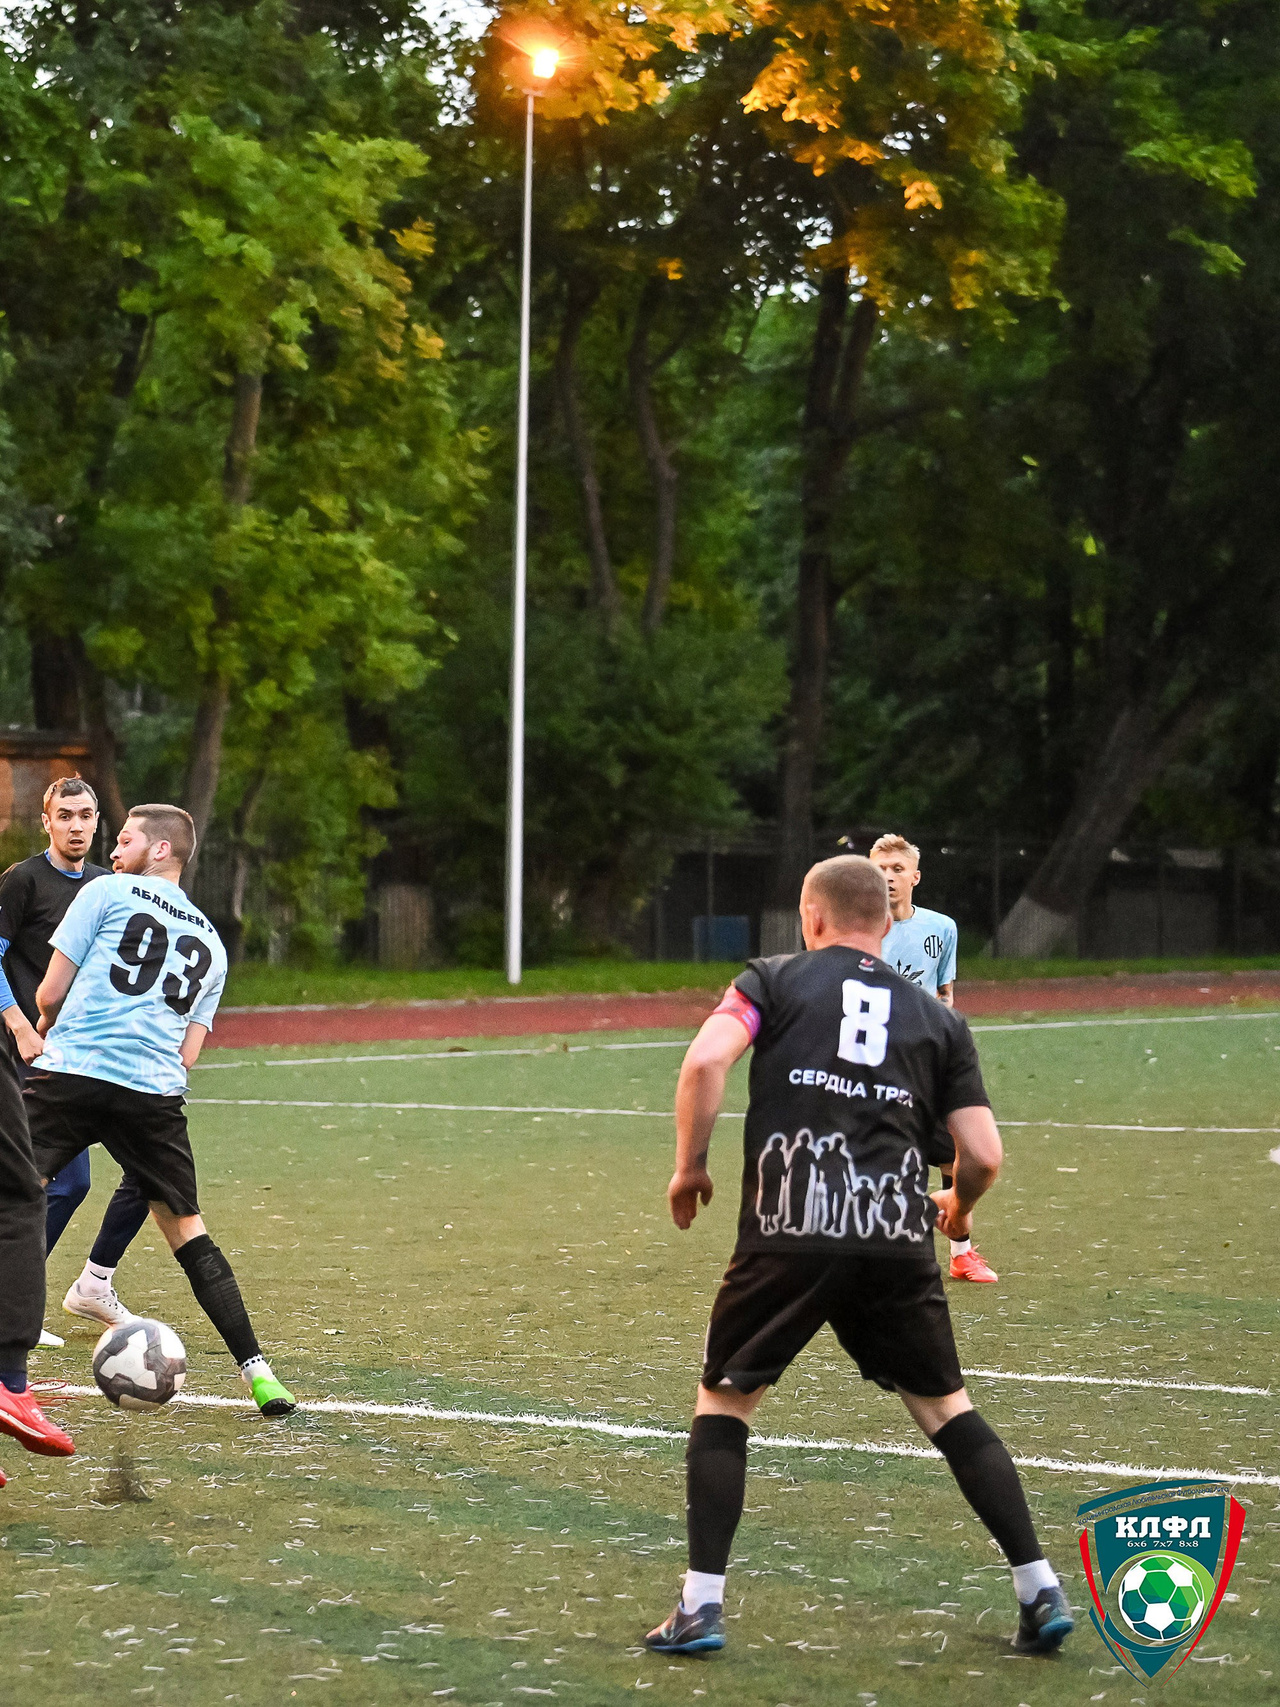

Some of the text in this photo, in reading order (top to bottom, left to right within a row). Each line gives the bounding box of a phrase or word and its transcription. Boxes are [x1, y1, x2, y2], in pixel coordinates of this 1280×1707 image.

[109, 912, 213, 1016] 93
[837, 978, 892, 1067] 8
[788, 1068, 868, 1098] СЕРДЦА
